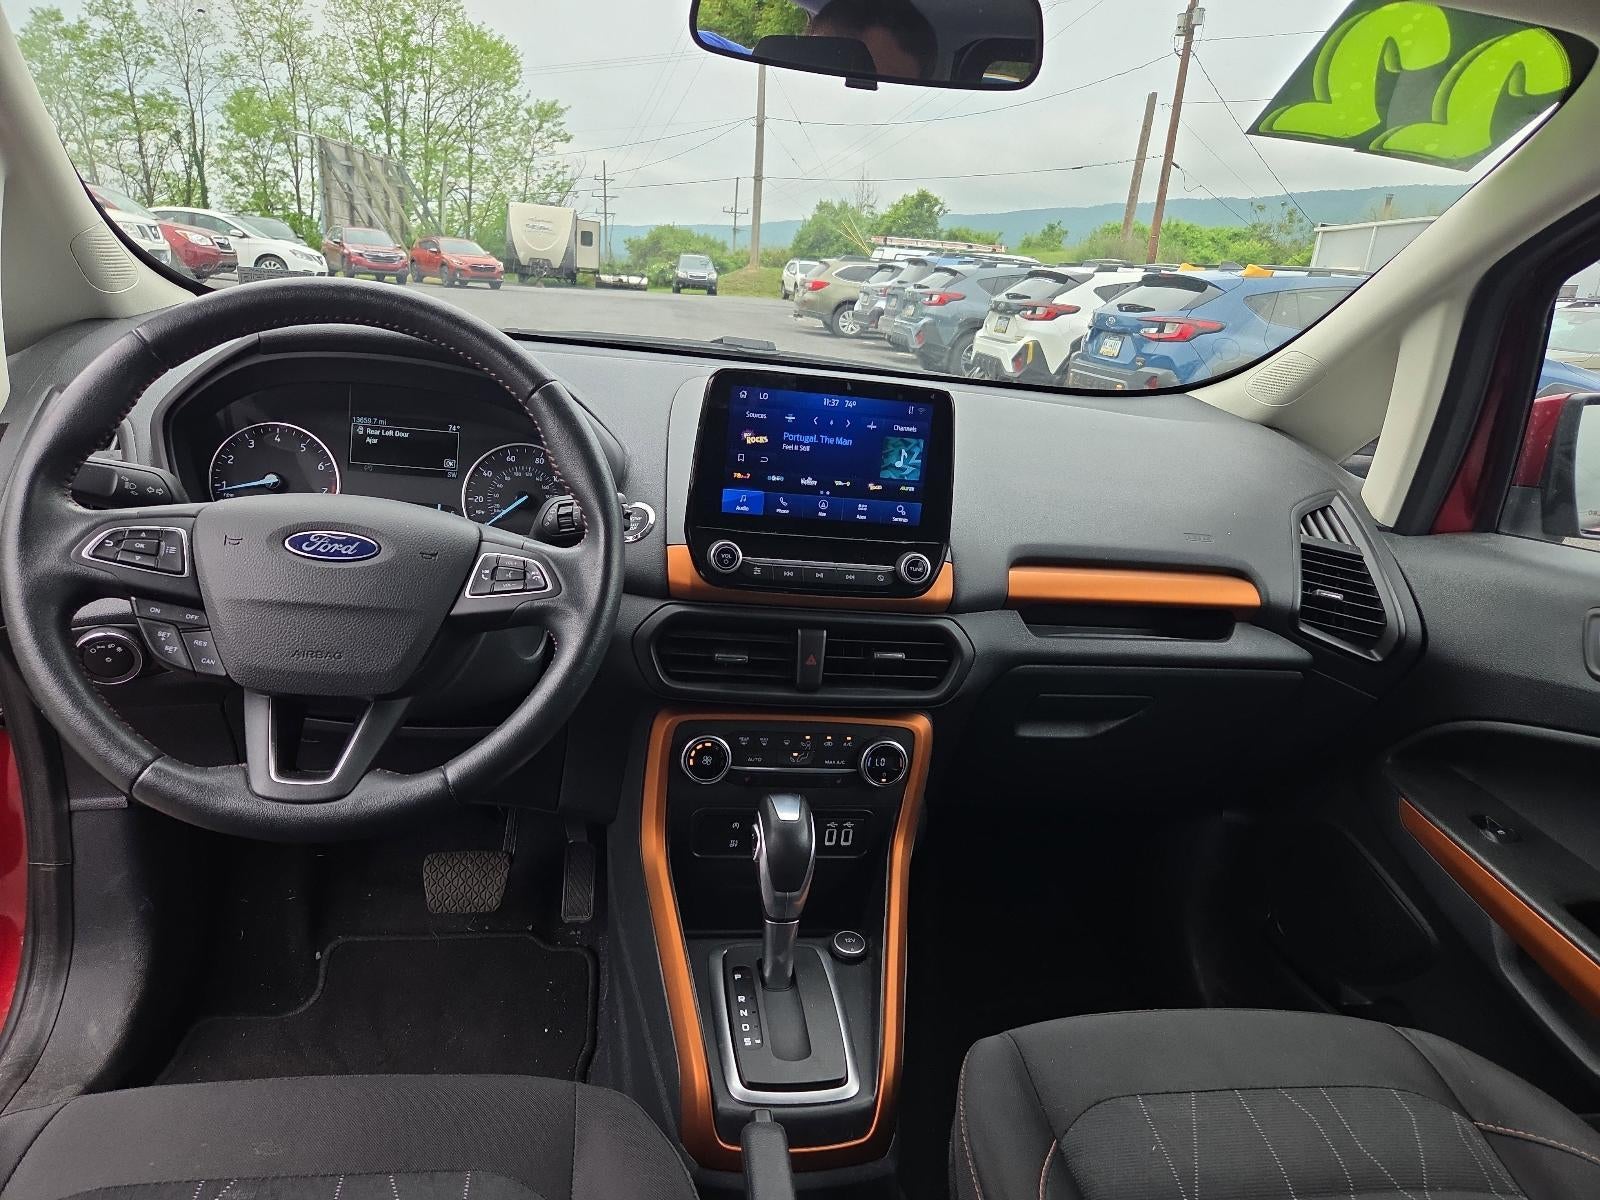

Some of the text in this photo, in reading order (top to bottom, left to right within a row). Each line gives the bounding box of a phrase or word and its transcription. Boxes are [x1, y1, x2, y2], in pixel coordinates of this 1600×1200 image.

[824, 398, 840, 407] 11:37
[746, 411, 767, 419] Sources
[366, 427, 380, 435] Rear
[382, 429, 394, 437] Left
[893, 425, 917, 433] Channels
[274, 434, 281, 442] 4
[366, 436, 378, 444] Ajar
[820, 435, 835, 444] The
[836, 437, 853, 446] Man
[248, 440, 255, 448] 3
[301, 443, 306, 452] 5
[227, 455, 234, 464] 2
[534, 457, 545, 465] 80
[318, 461, 325, 470] 6
[448, 471, 458, 479] SW
[474, 495, 484, 503] 20
[302, 533, 359, 556] Ford
[185, 613, 200, 621] OFF
[157, 631, 171, 639] SET
[193, 639, 208, 647] RES
[164, 645, 178, 653] SET
[291, 649, 343, 660] AIRBAG
[201, 658, 216, 666] CAN
[875, 757, 886, 767] LO
[740, 1009, 748, 1017] N
[742, 1023, 750, 1031] D
[744, 1037, 751, 1046] S
